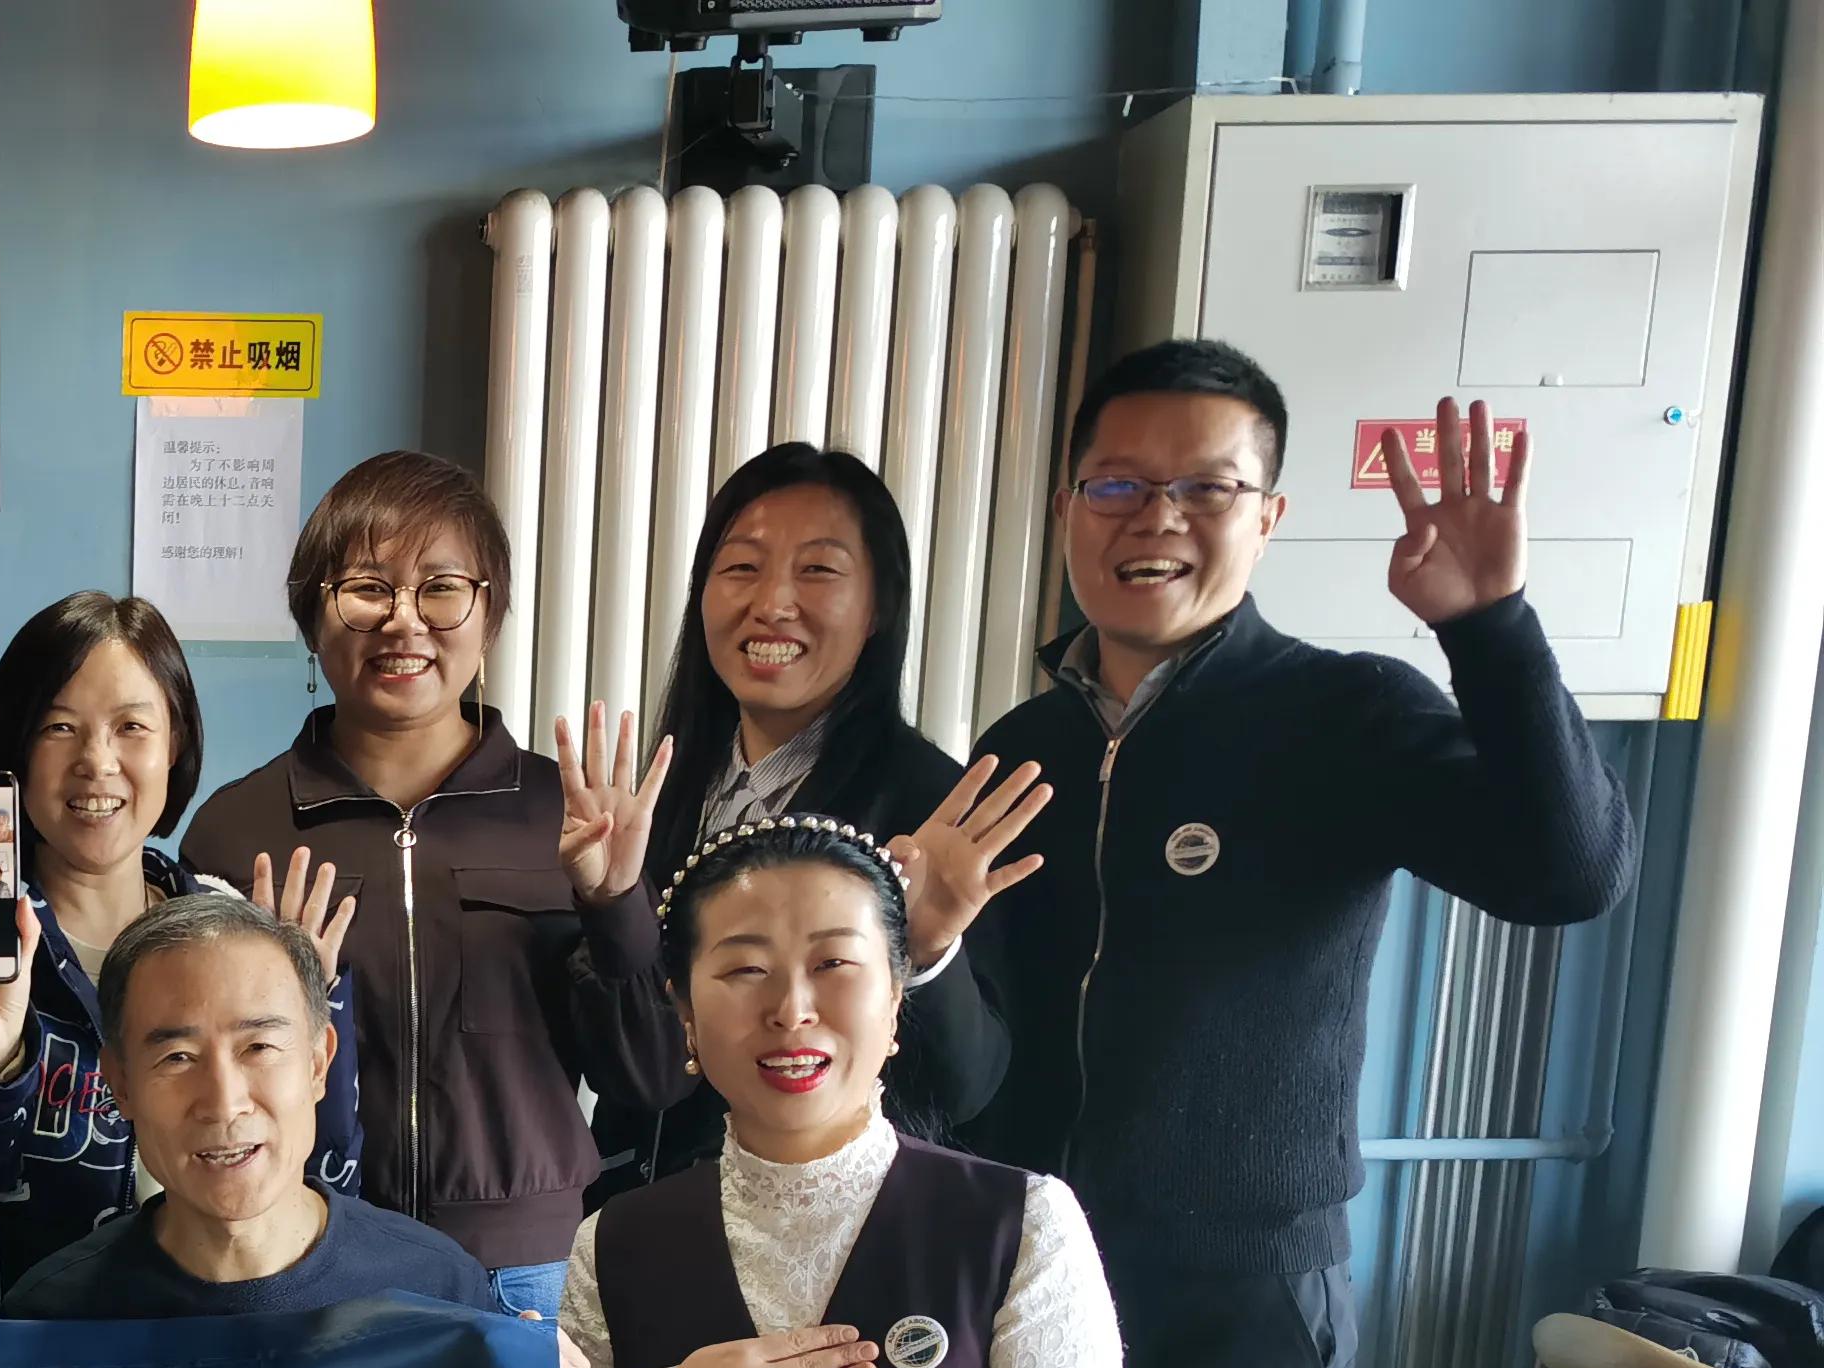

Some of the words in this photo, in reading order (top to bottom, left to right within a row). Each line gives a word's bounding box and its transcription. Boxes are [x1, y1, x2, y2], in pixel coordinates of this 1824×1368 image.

[190, 338, 301, 372] 禁止吸烟
[190, 458, 275, 472] 为了不影响周
